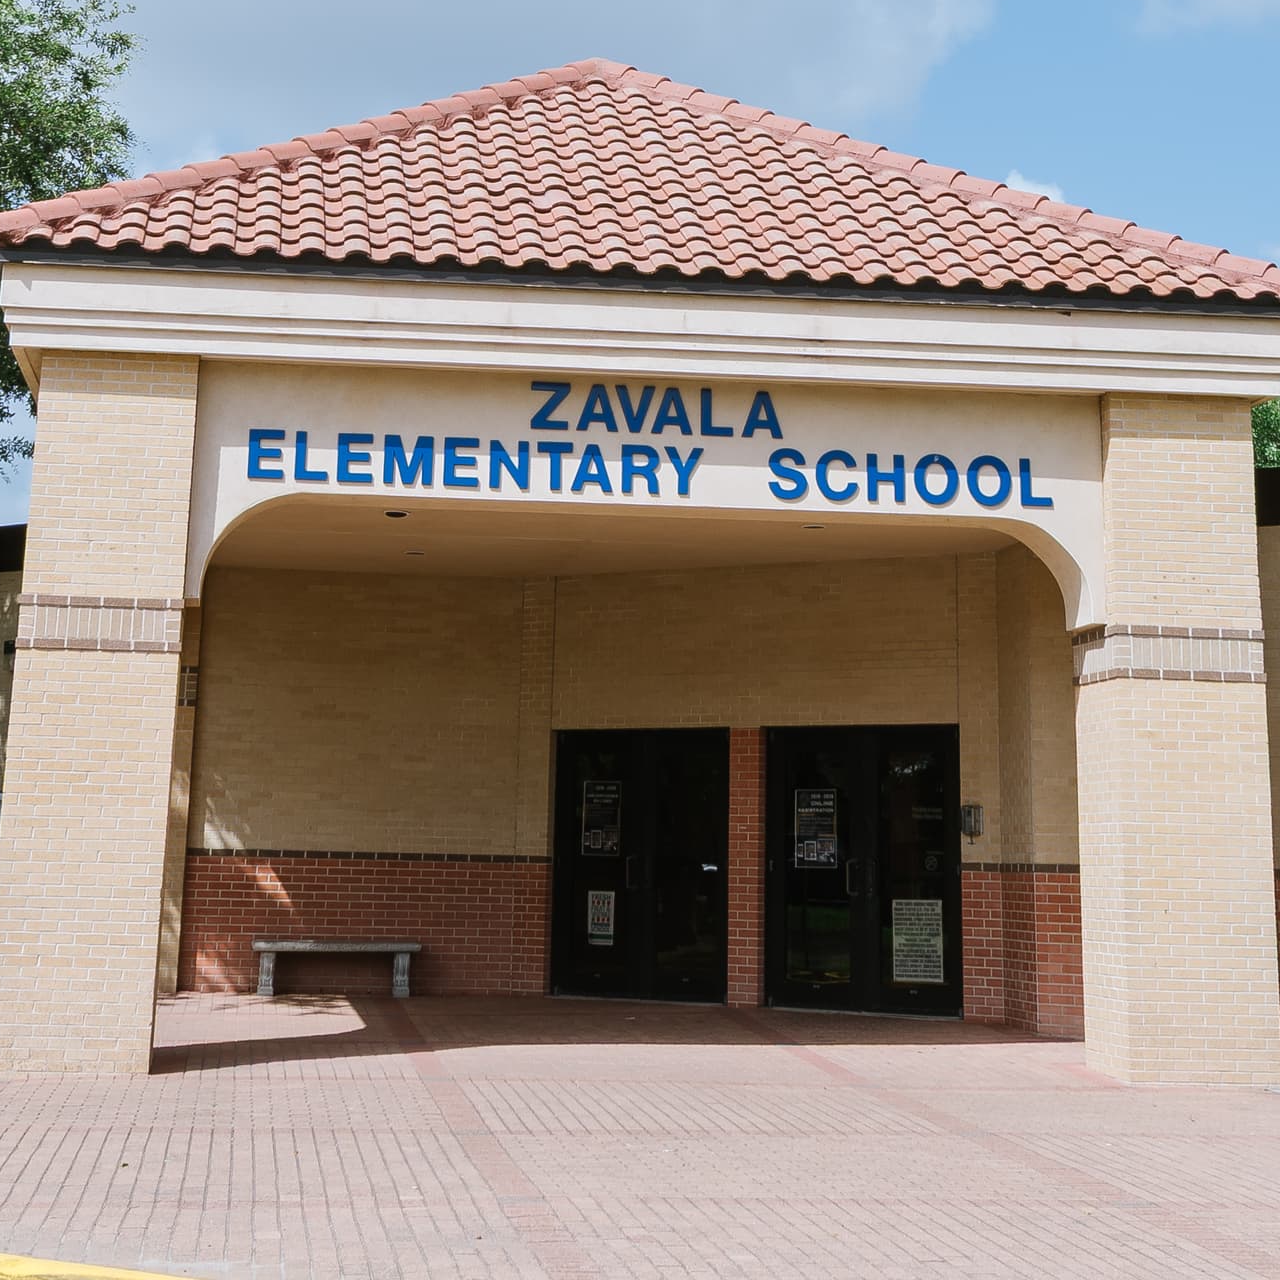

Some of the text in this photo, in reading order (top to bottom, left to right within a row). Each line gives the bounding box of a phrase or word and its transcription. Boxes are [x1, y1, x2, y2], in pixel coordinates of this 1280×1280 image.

[530, 381, 783, 439] ZAVALA
[247, 429, 1054, 507] ELEMENTARY SCHOOL
